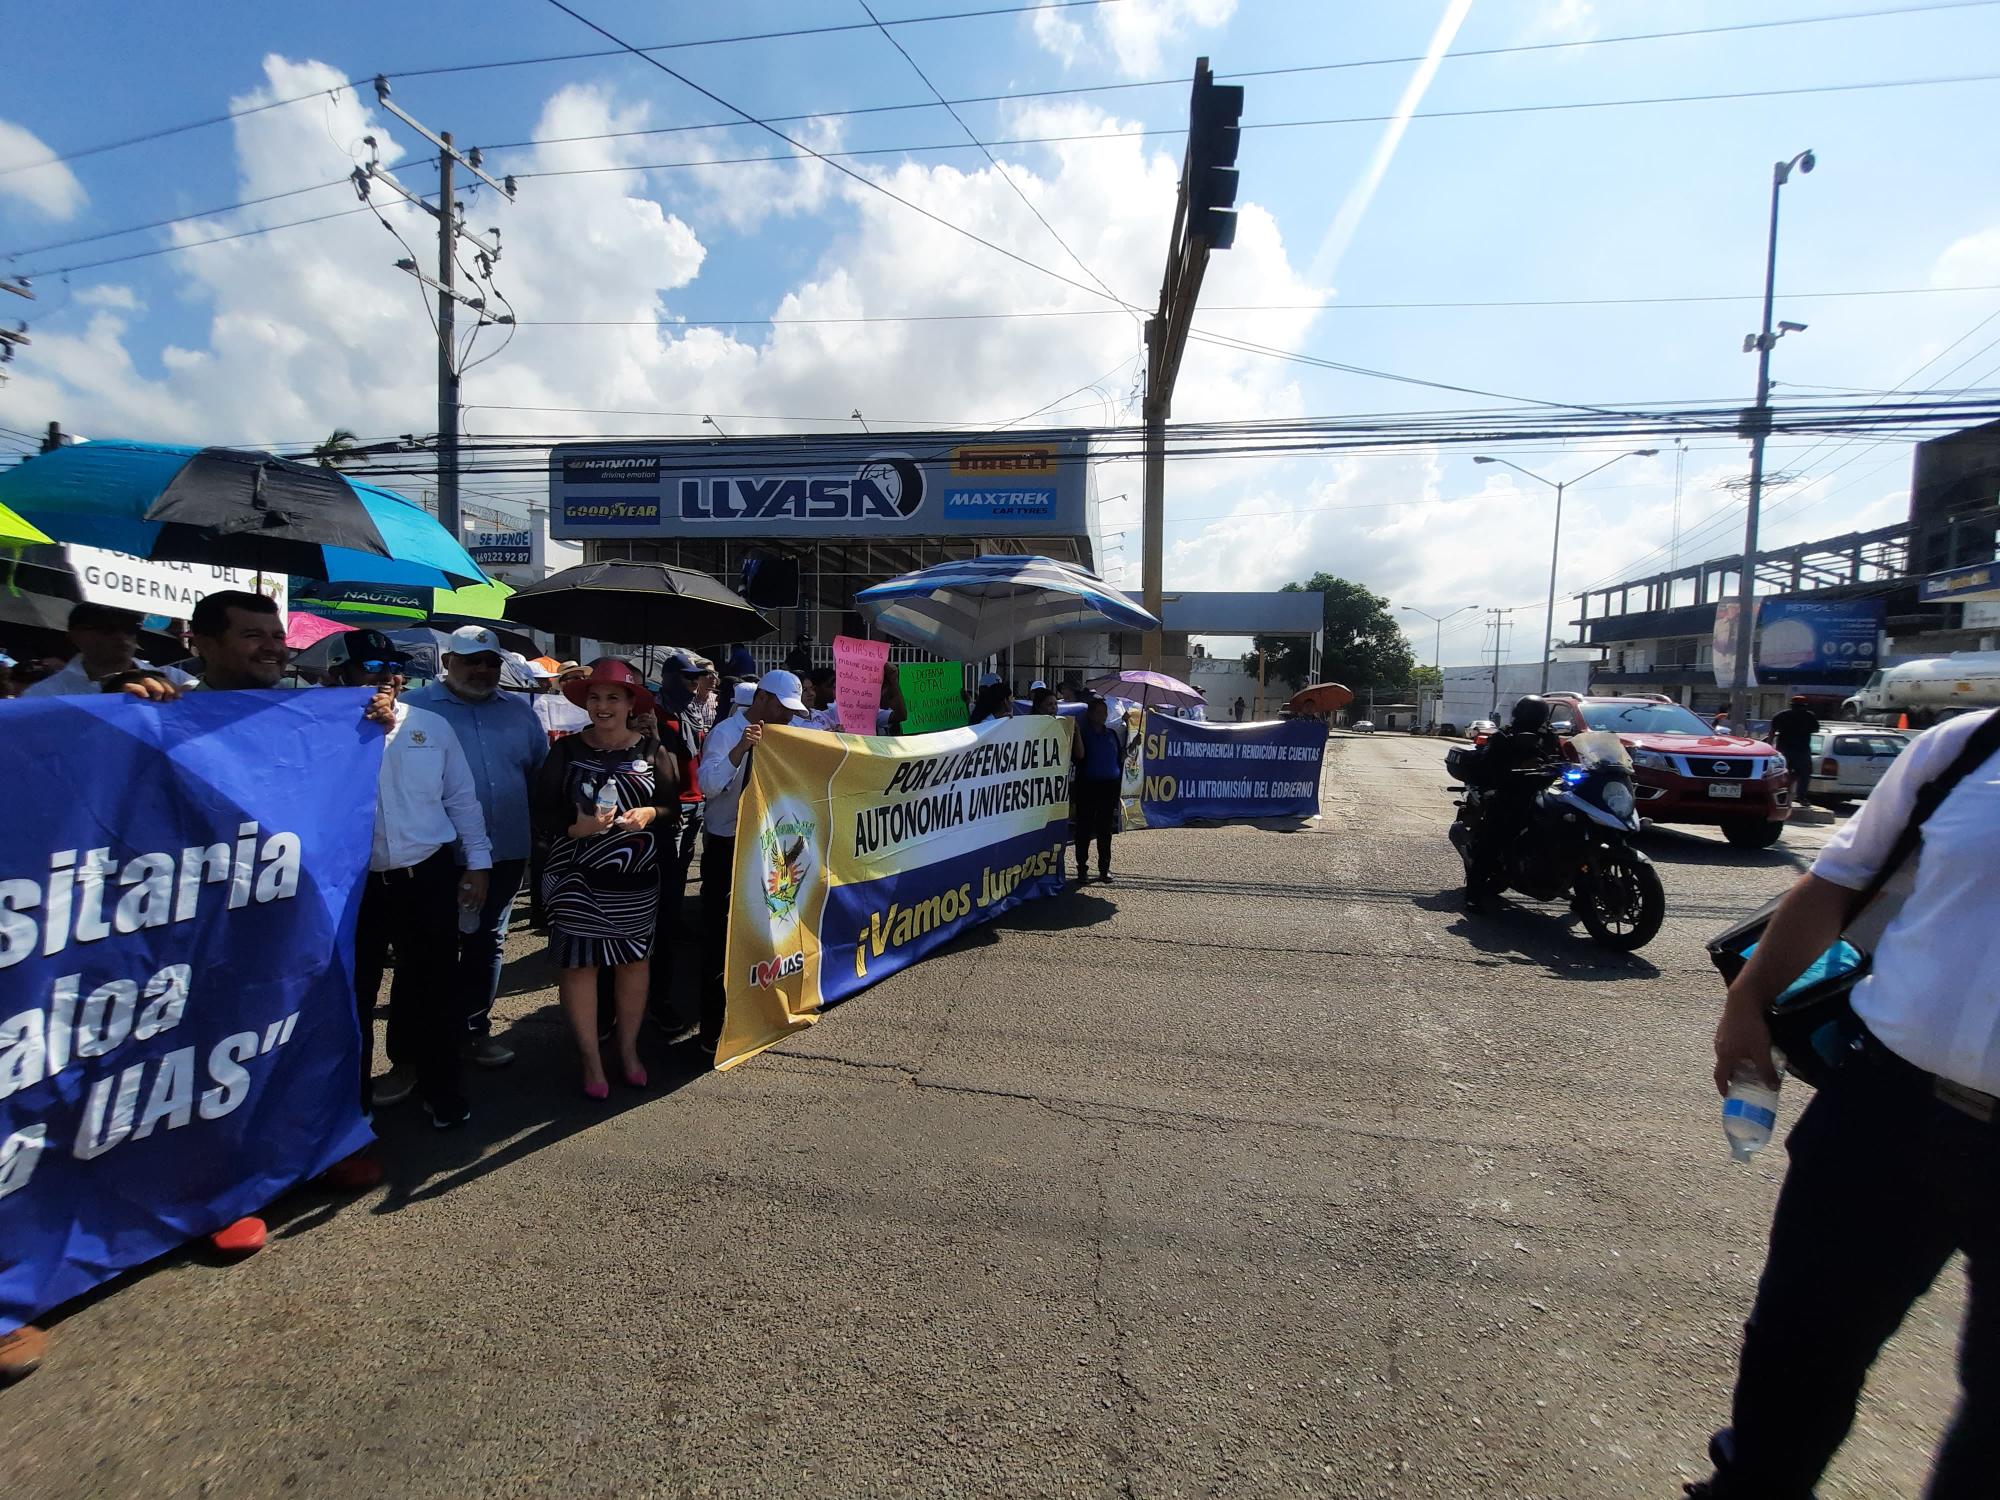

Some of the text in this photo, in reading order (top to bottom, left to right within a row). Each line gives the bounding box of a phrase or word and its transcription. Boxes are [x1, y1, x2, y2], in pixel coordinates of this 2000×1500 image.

[601, 471, 656, 479] driving emotion
[949, 492, 1050, 506] MAXTREK
[992, 507, 1048, 515] CAR TYRES
[479, 530, 529, 546] SE VENDE
[505, 552, 516, 562] 92
[517, 552, 529, 562] 87
[211, 564, 240, 584] DEL
[344, 591, 420, 606] NAUTICA
[1146, 728, 1321, 762] SÍ A LA TRANSPARENCIA Y RENDICIÓN DE CUENTAS
[884, 737, 1061, 796] POR LA DEFENSA DE LA
[1143, 775, 1177, 802] NO
[1178, 780, 1184, 798] A
[1185, 780, 1196, 799] LA
[1198, 776, 1252, 799] INTROMISIÓN
[1254, 781, 1269, 799] DEL
[1270, 780, 1314, 799] GOBIERNO
[854, 784, 964, 858] AUTONOMÍA
[968, 773, 1070, 823] UNIVERSITARI
[855, 882, 971, 978] ¡Vamos
[779, 952, 804, 980] UAS
